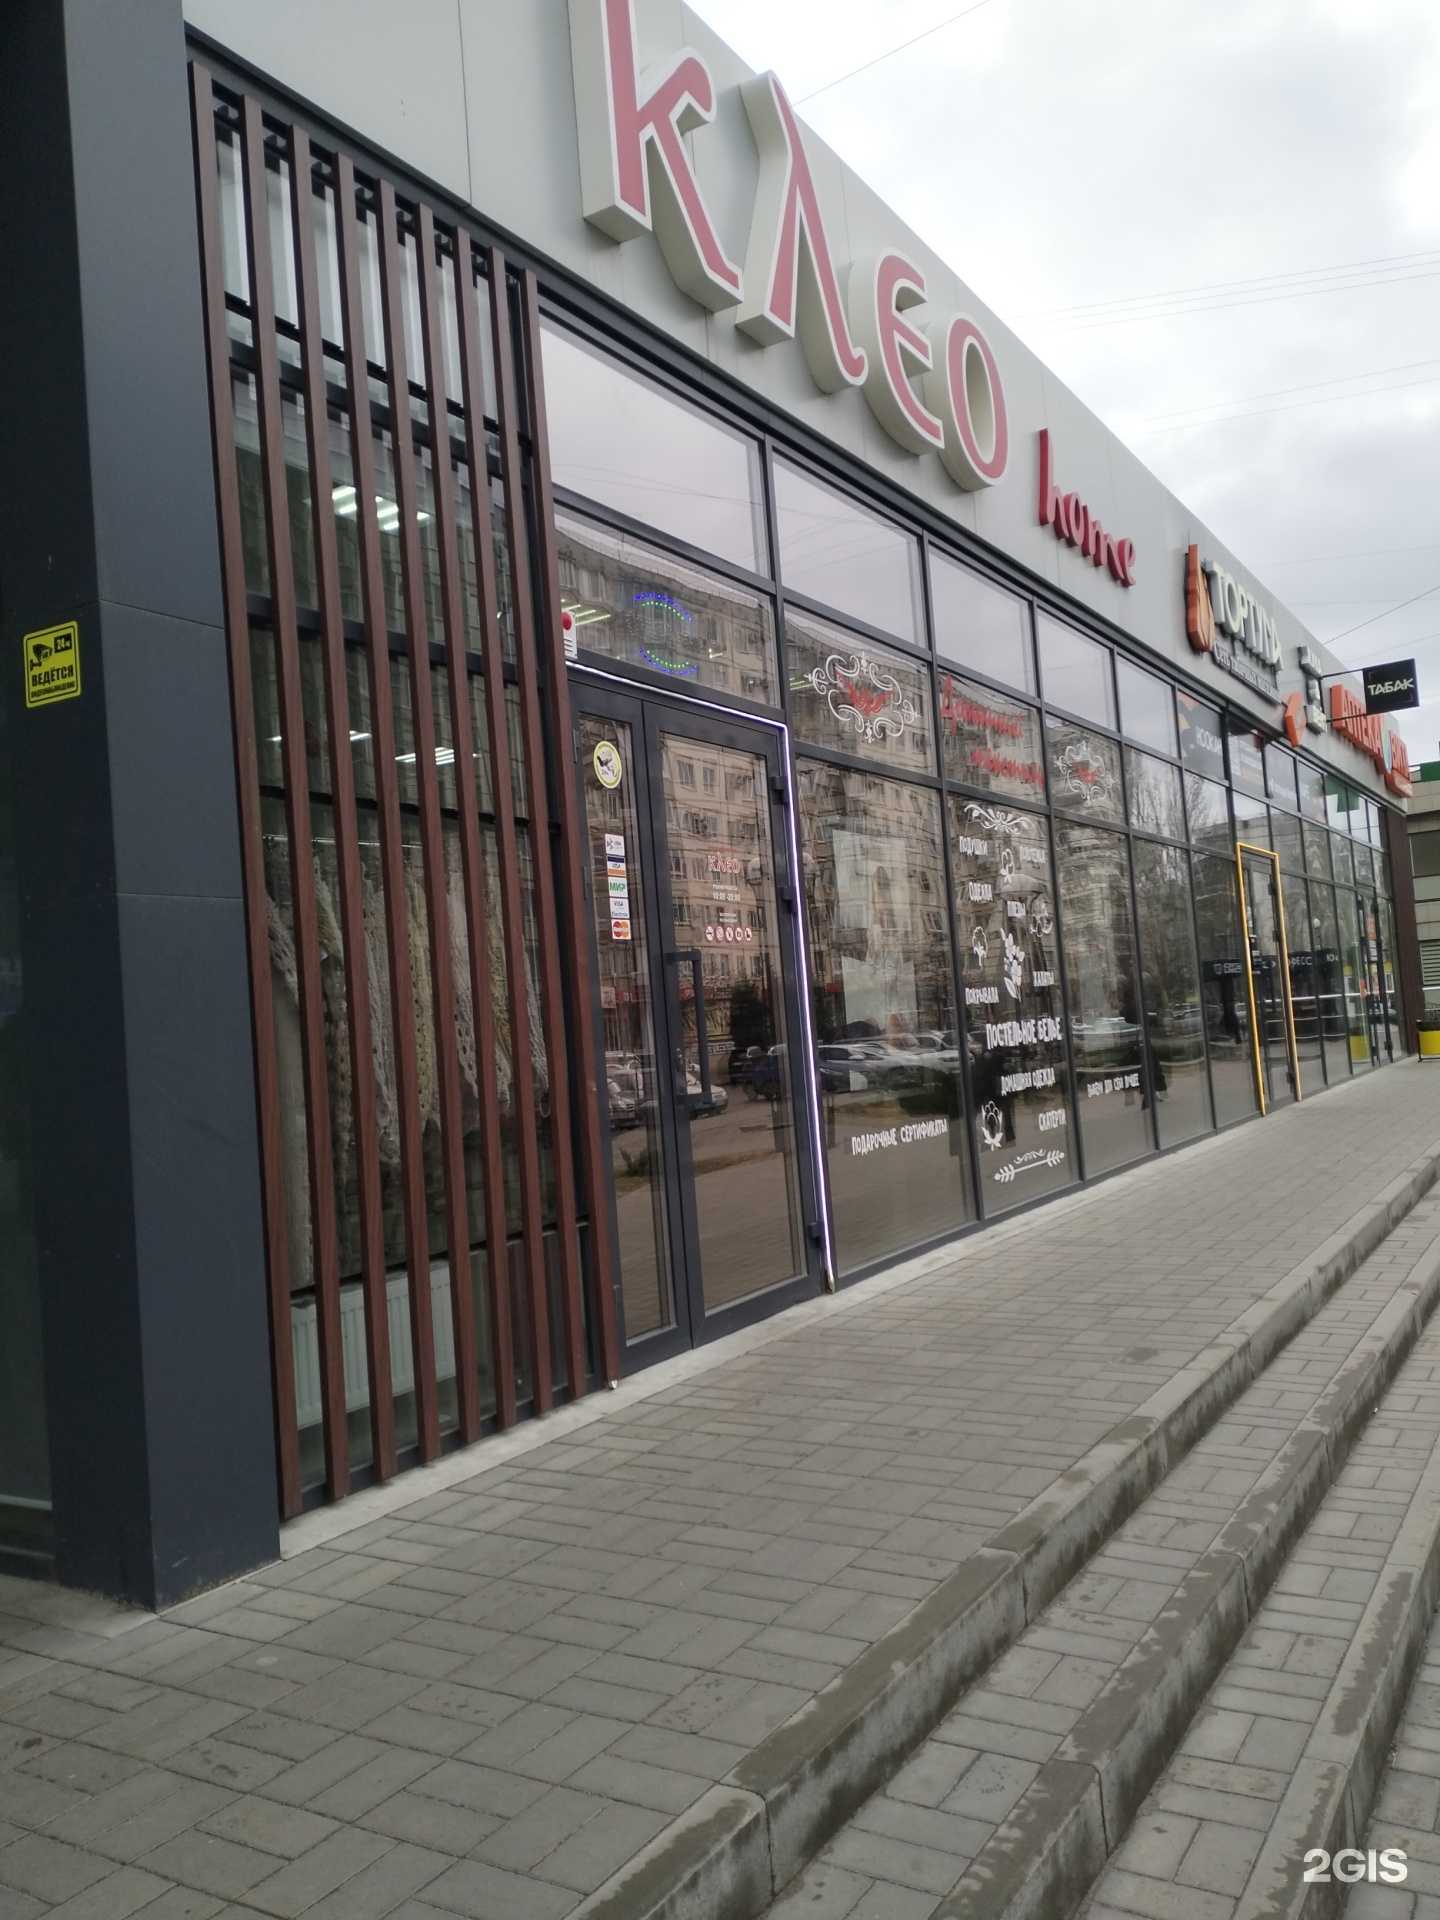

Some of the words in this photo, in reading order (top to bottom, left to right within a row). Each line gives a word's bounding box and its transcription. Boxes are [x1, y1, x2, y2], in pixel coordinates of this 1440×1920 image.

[570, 0, 1010, 491] КЛЕО
[1036, 427, 1137, 587] home
[1367, 678, 1415, 697] ТАБАК
[609, 882, 626, 892] МИР
[965, 986, 1000, 1006] ПОКРЫВАЛА
[986, 1019, 1038, 1050] ПОСТЕЛЬНОЕ
[1032, 1067, 1056, 1090] ОДЕЖДА
[1039, 1108, 1066, 1132] СКАТЕРТИ
[851, 1127, 898, 1156] ПОДАРОЧНЫЕ
[900, 1118, 948, 1143] СЕРТИФИКАТЫ
